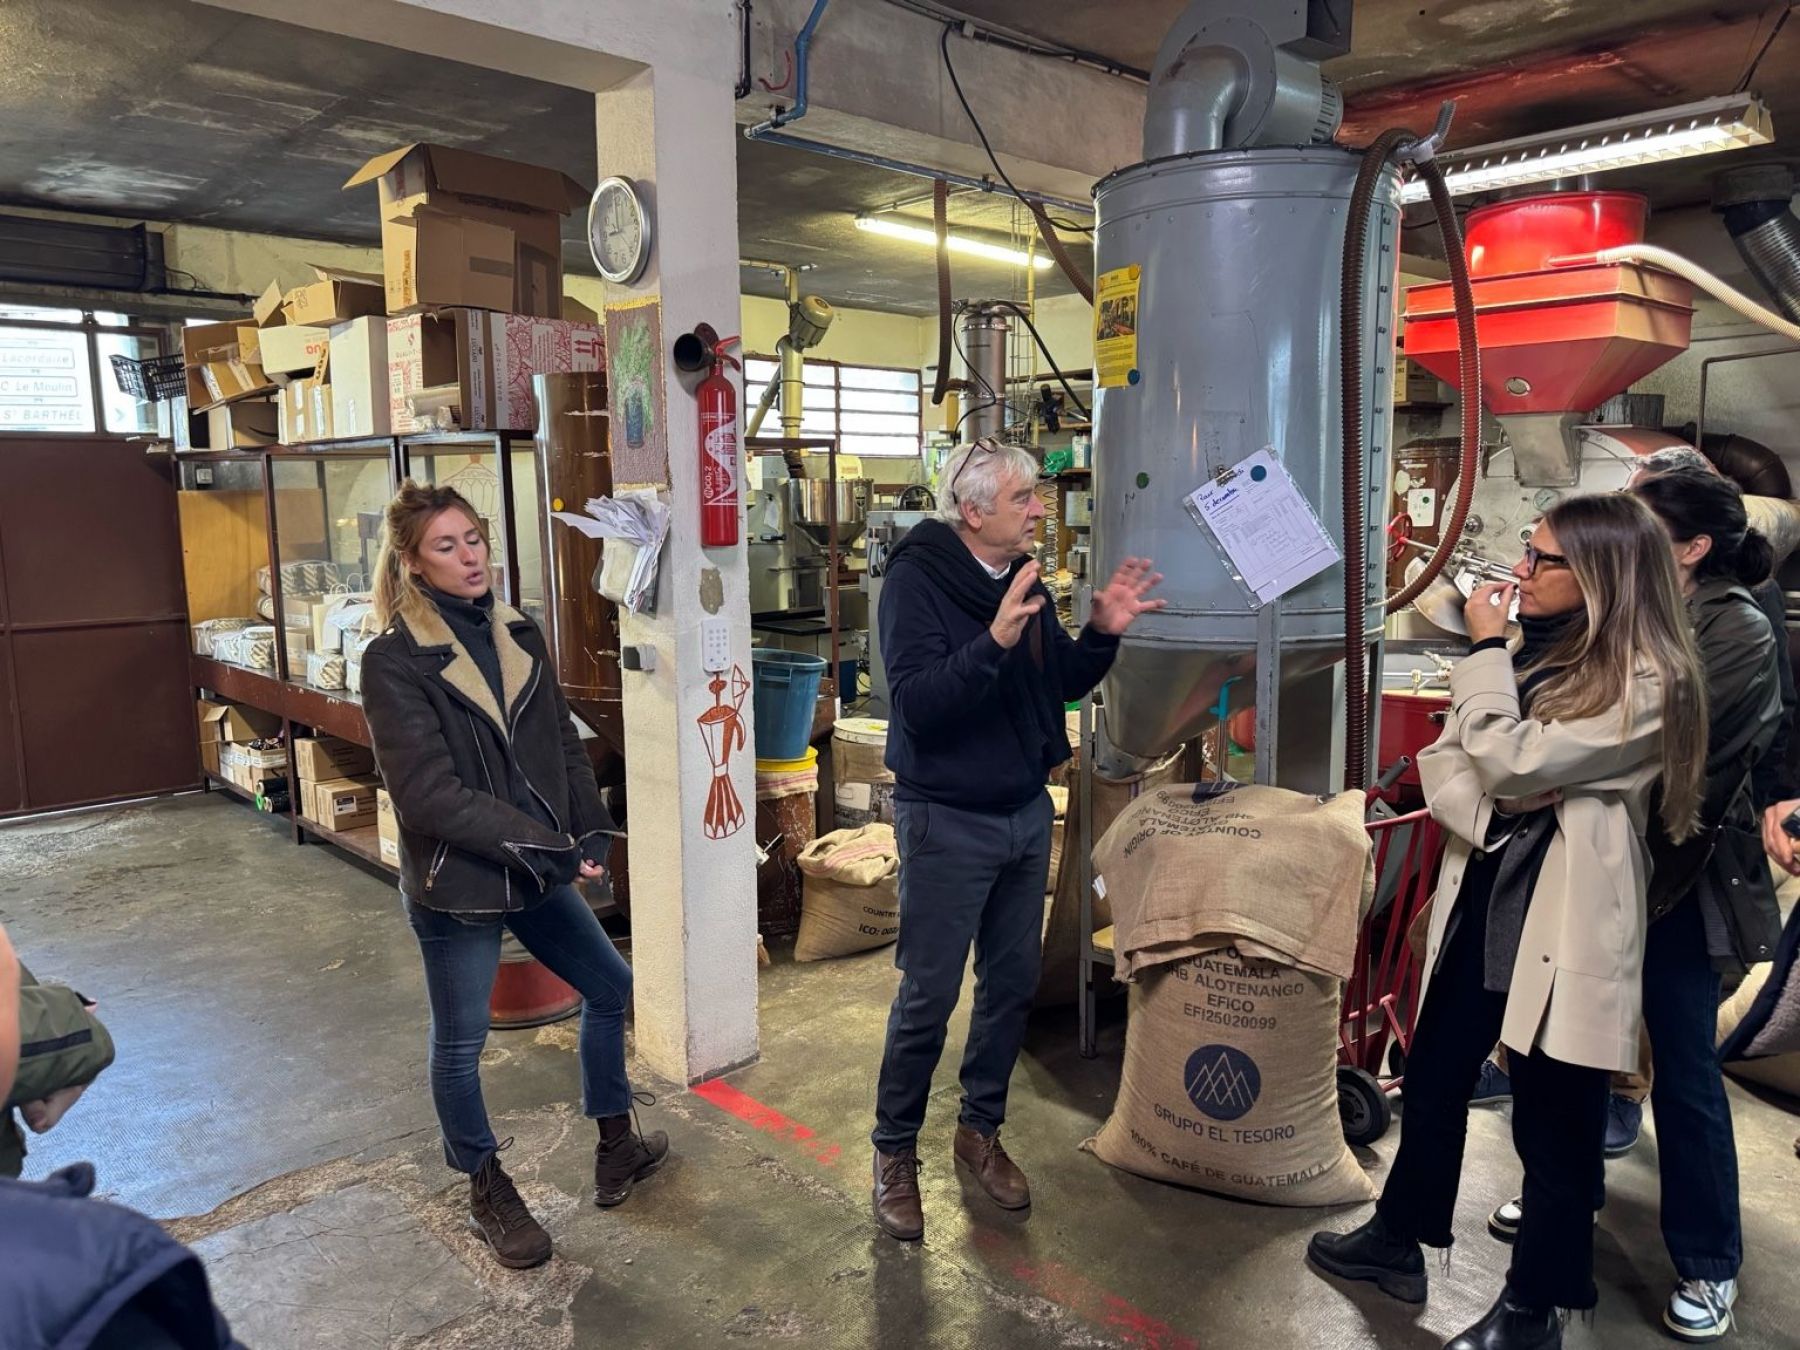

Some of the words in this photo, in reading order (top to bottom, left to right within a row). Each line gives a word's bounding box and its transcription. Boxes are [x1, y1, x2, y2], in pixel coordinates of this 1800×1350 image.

[1194, 973, 1305, 998] ALOTENANGO
[1184, 1003, 1278, 1030] EFI25020099
[1207, 993, 1255, 1013] EFICO
[1153, 1103, 1204, 1137] GRUPO
[1208, 1126, 1229, 1143] EL
[1232, 1124, 1296, 1145] TESORO
[1130, 1128, 1158, 1158] 100%
[1161, 1151, 1201, 1173] CAFÉ
[1205, 1166, 1227, 1182] DE
[1231, 1163, 1326, 1188] GUATEMALA
